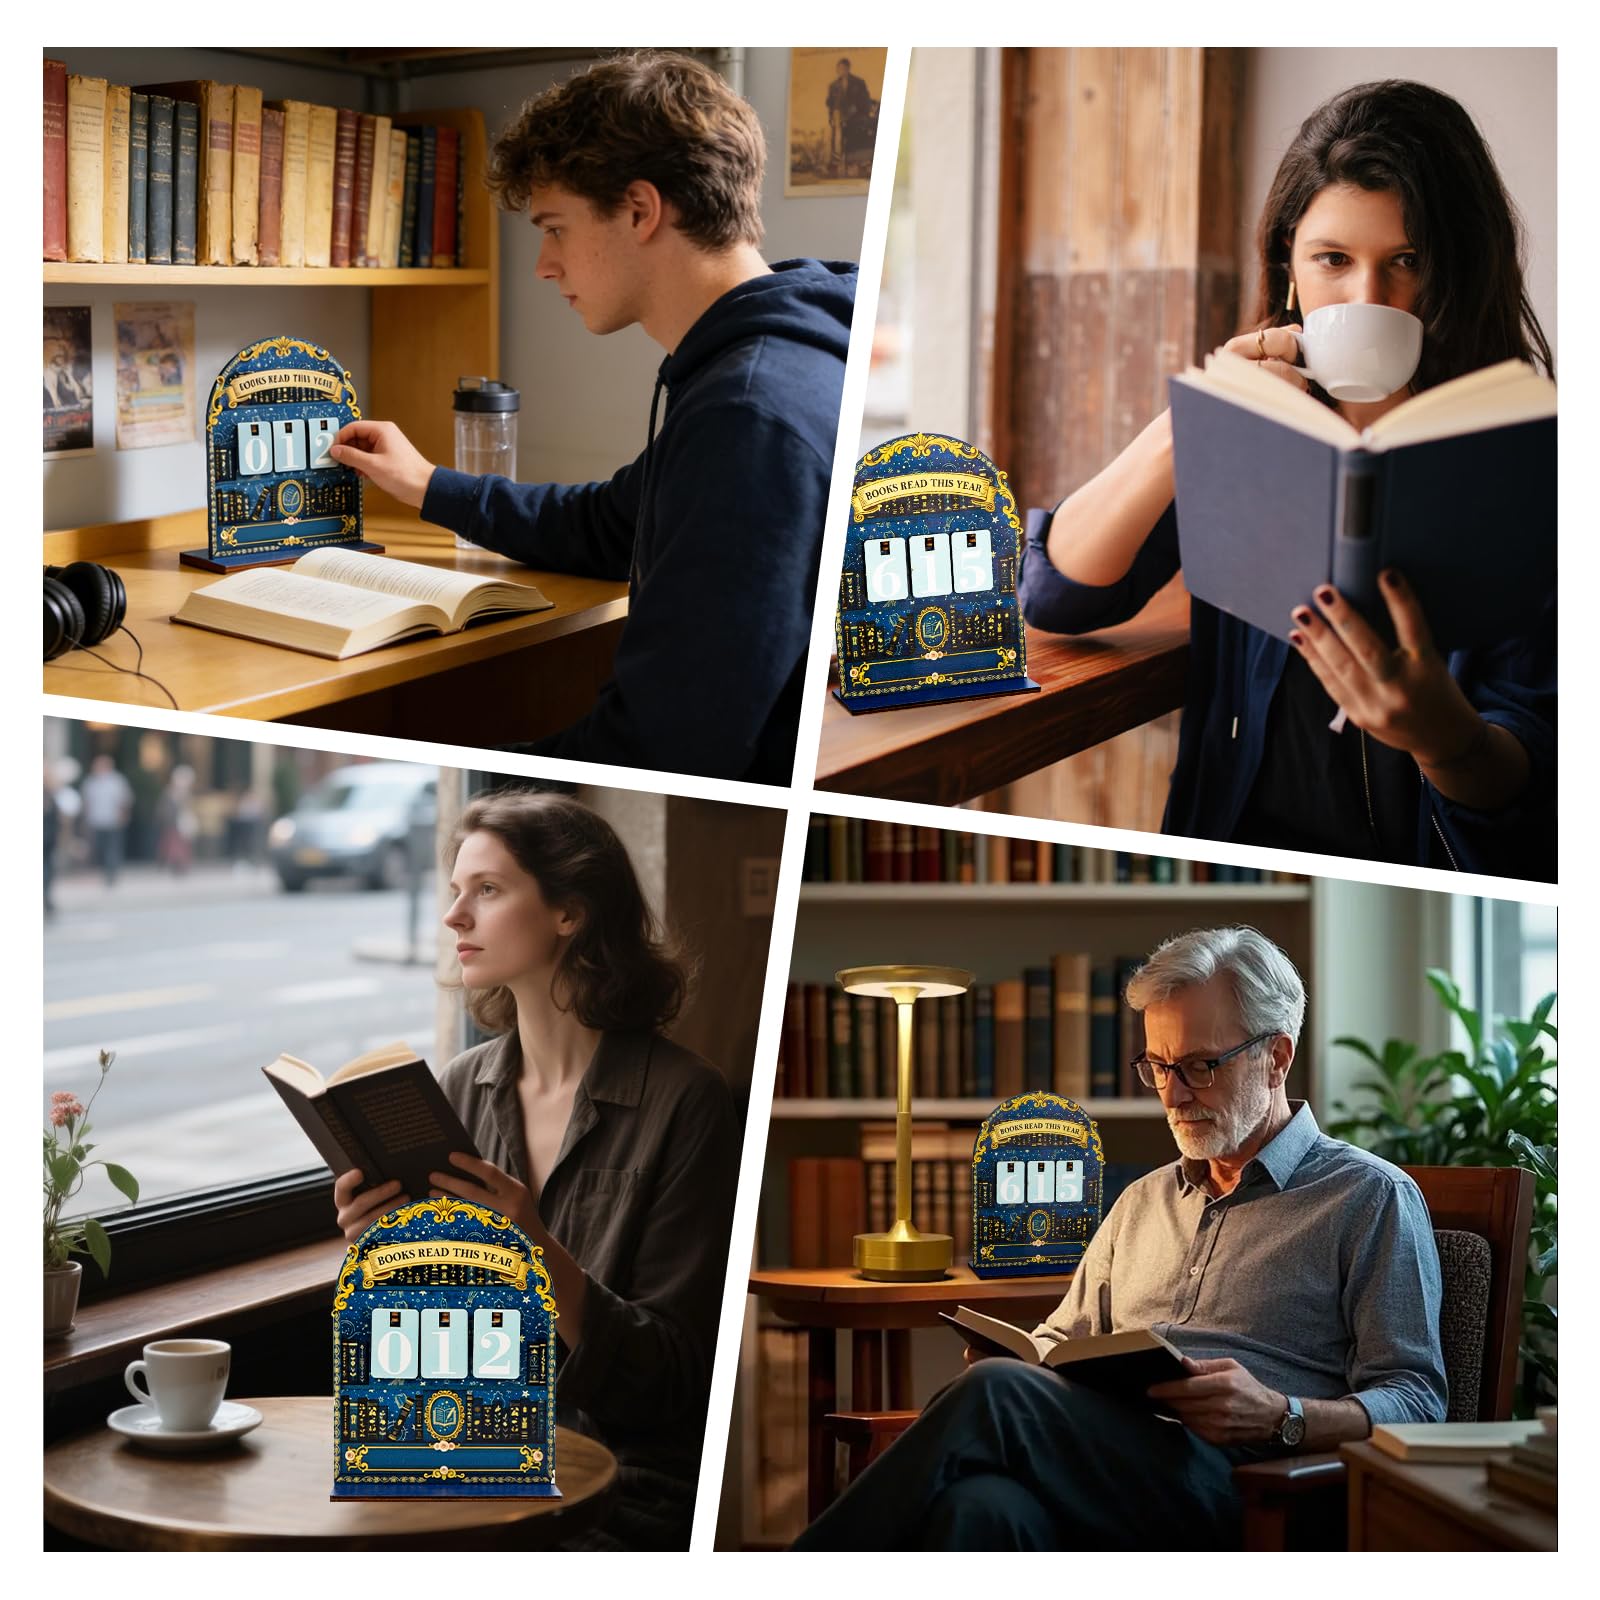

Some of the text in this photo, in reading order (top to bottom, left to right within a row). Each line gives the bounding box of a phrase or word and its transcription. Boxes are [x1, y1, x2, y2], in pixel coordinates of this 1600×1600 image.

[865, 478, 982, 501] BOOKS READ THIS YEAR
[1000, 1122, 1080, 1135] BOOKS READ THIS YEAR
[377, 1247, 513, 1268] BOOKS READ THIS YEAR
